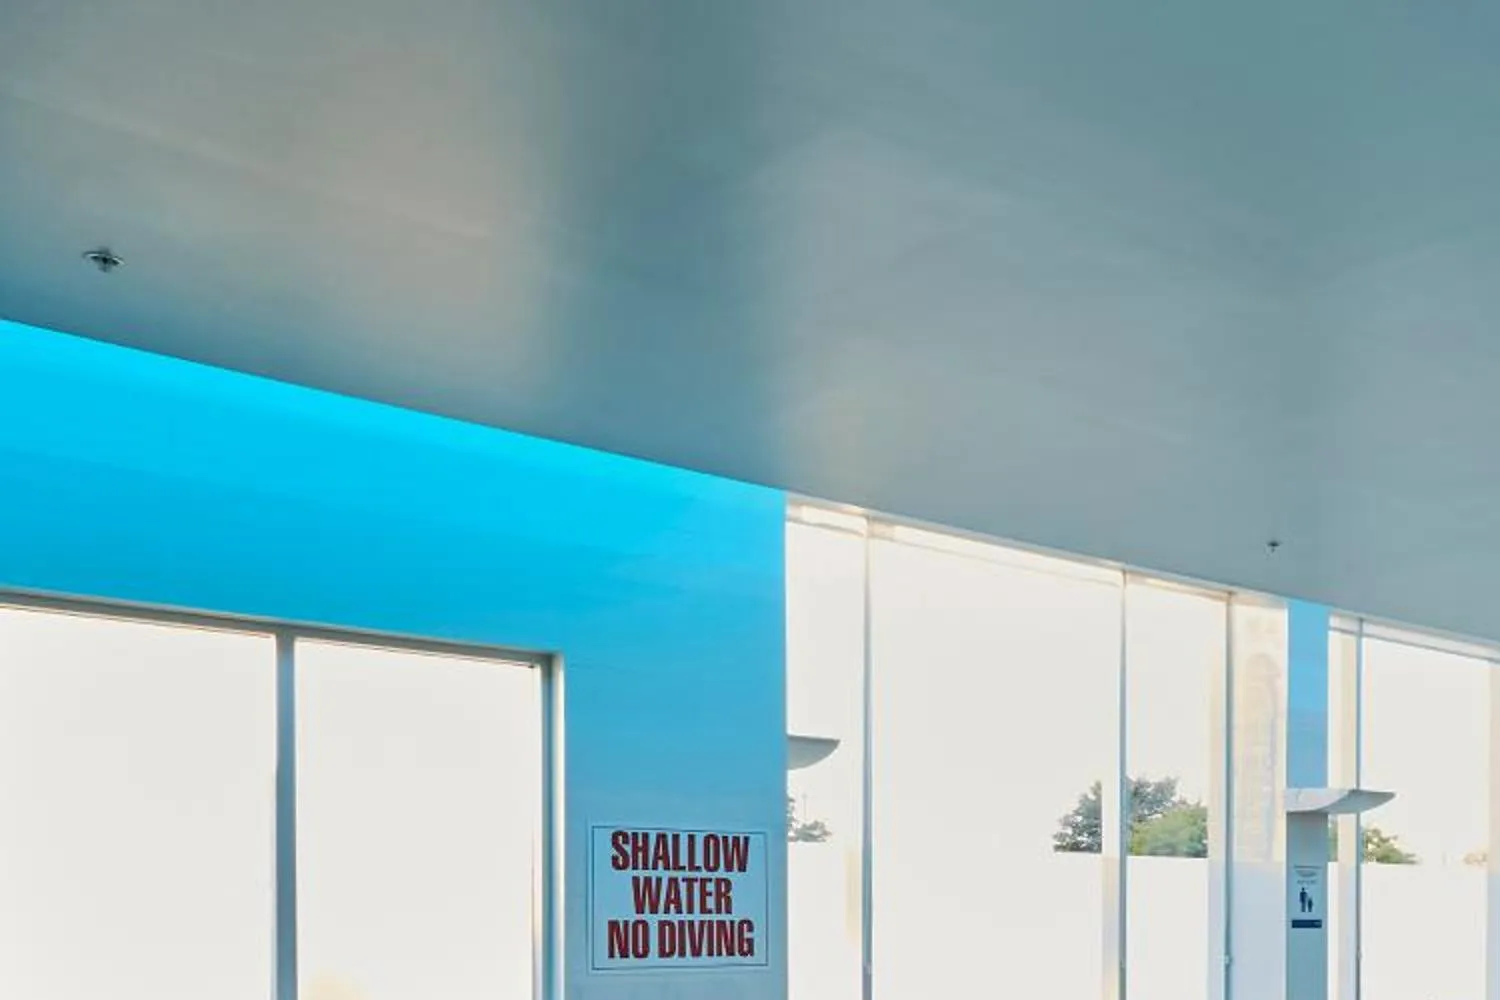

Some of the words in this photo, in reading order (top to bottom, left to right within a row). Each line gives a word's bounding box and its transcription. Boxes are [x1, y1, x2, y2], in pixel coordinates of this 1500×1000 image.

[611, 830, 750, 872] SHALLOW
[632, 876, 733, 915] WATER
[607, 919, 650, 959] NO
[657, 919, 755, 958] DIVING
